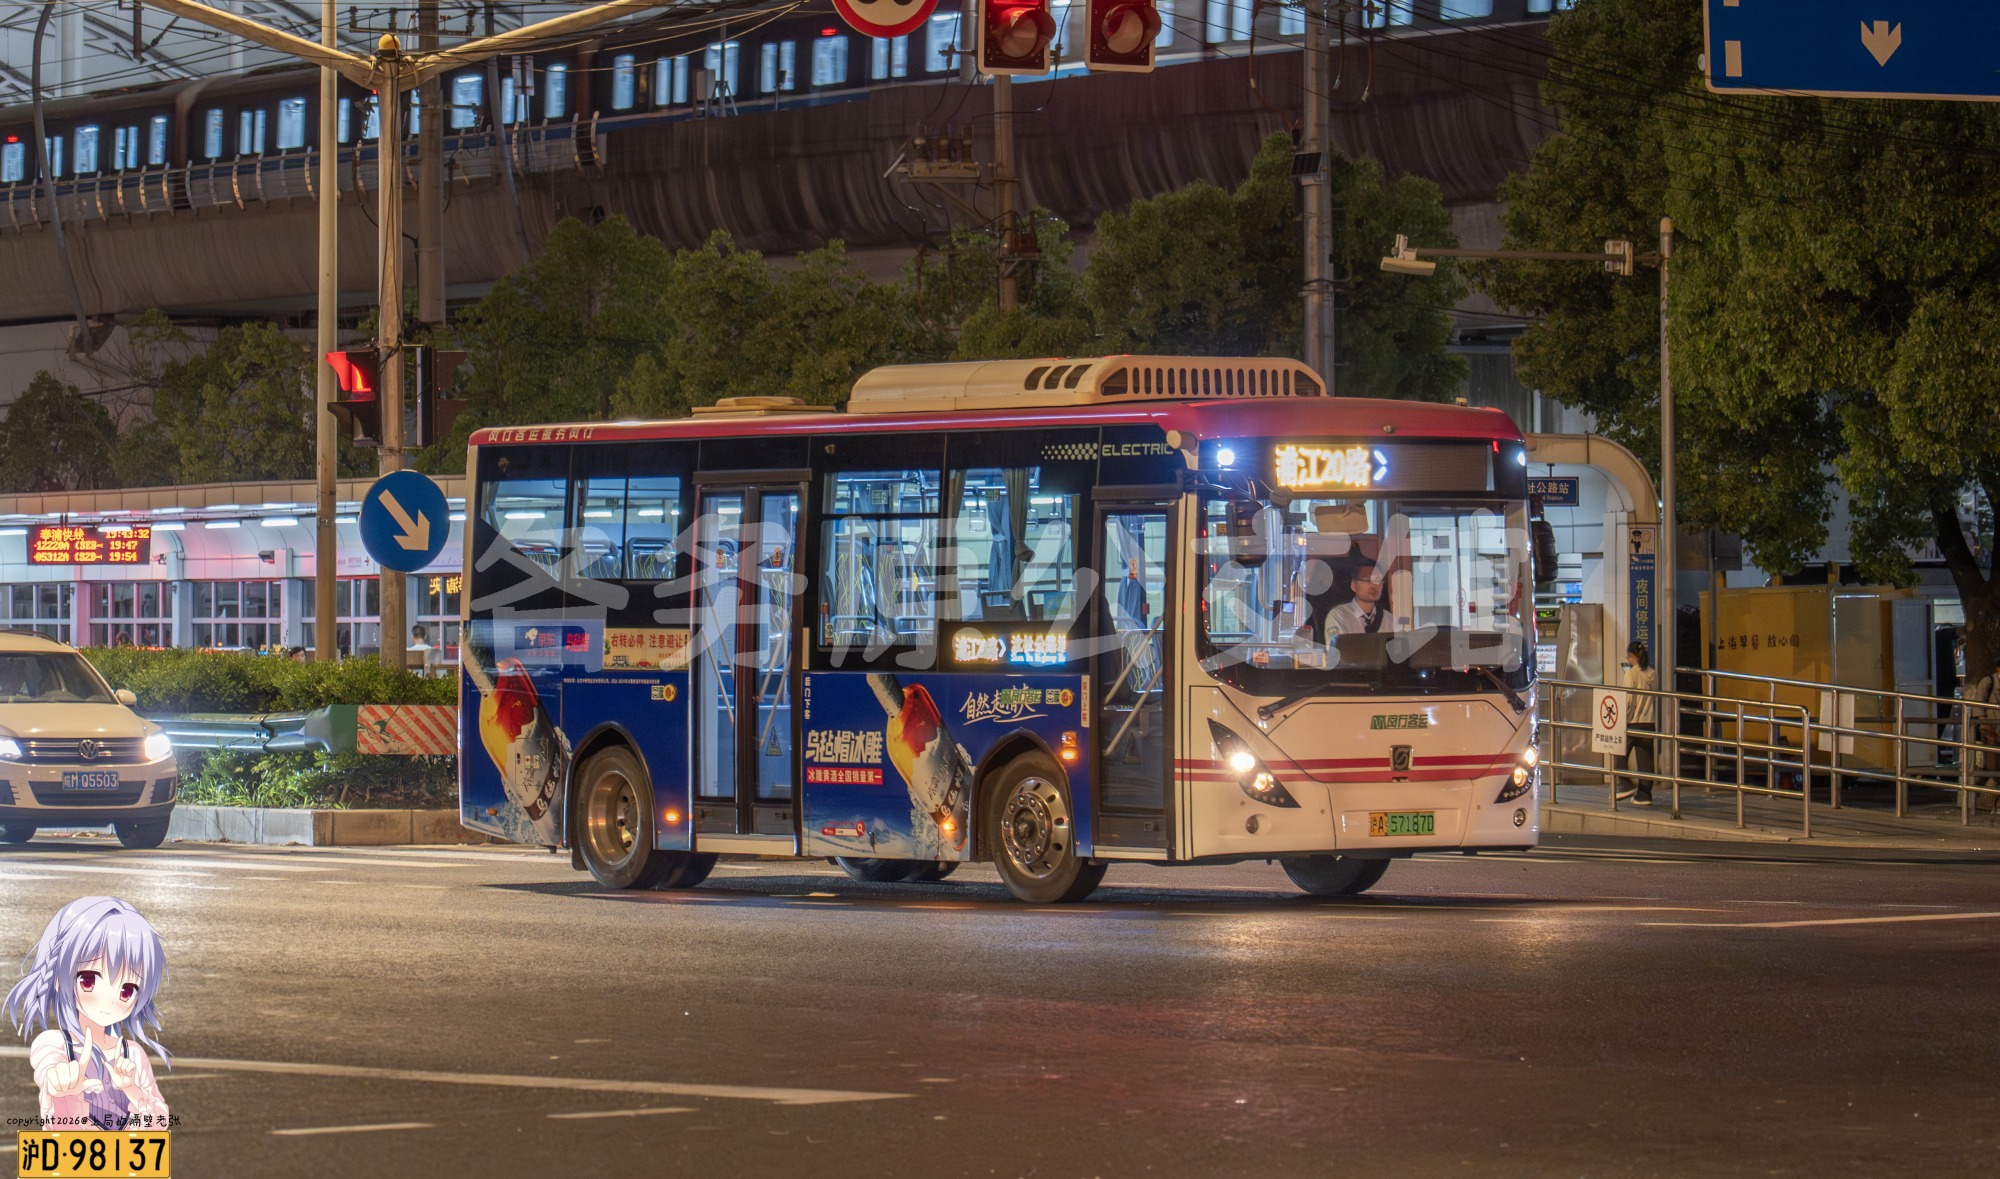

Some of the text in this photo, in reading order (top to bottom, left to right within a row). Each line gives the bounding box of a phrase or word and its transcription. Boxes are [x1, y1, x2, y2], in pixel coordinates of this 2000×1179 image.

[1102, 443, 1174, 456] ELECTRIC
[110, 541, 138, 550] 19:47
[110, 552, 137, 561] 19:54
[611, 633, 684, 649] 右转必停 注意避让
[1386, 713, 1429, 729] 闵行客运
[805, 729, 883, 764] 乌毡帽冰雕
[808, 768, 882, 783] 冰雕黄酒全国销量第一
